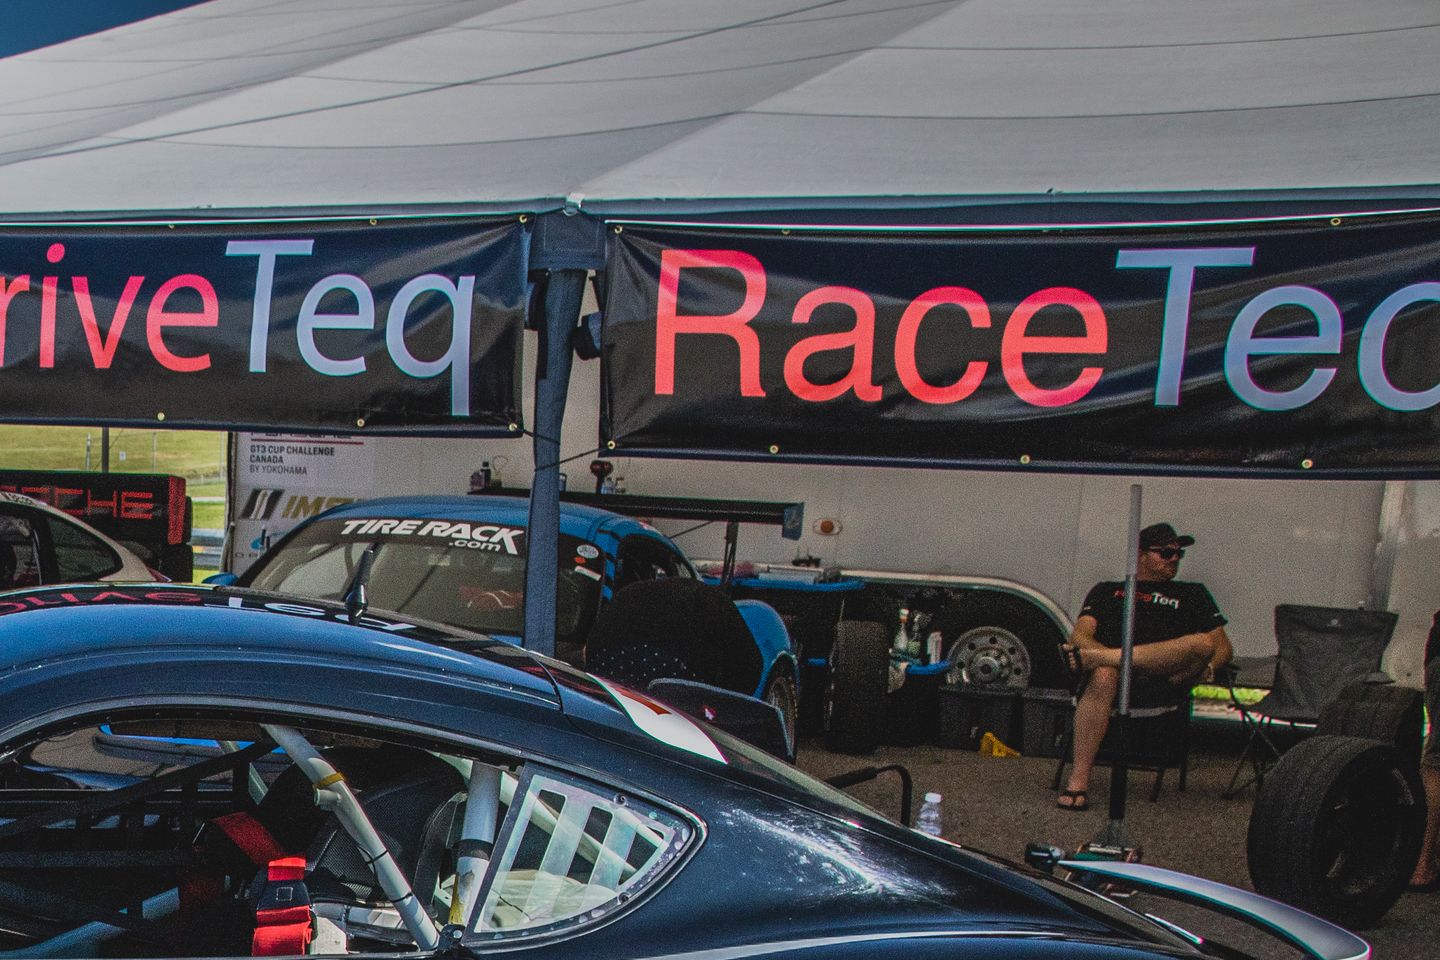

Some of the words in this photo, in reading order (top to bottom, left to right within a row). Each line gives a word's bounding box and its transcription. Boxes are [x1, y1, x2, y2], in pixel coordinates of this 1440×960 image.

[250, 445, 266, 453] GT3
[268, 445, 285, 454] CUP
[286, 446, 335, 456] CHALLENGE
[249, 455, 283, 463] CANADA
[249, 464, 259, 473] BY
[262, 465, 307, 475] YOKOHAMA
[341, 519, 423, 536] TIRE
[417, 521, 525, 555] RACK
[449, 540, 501, 552] .com
